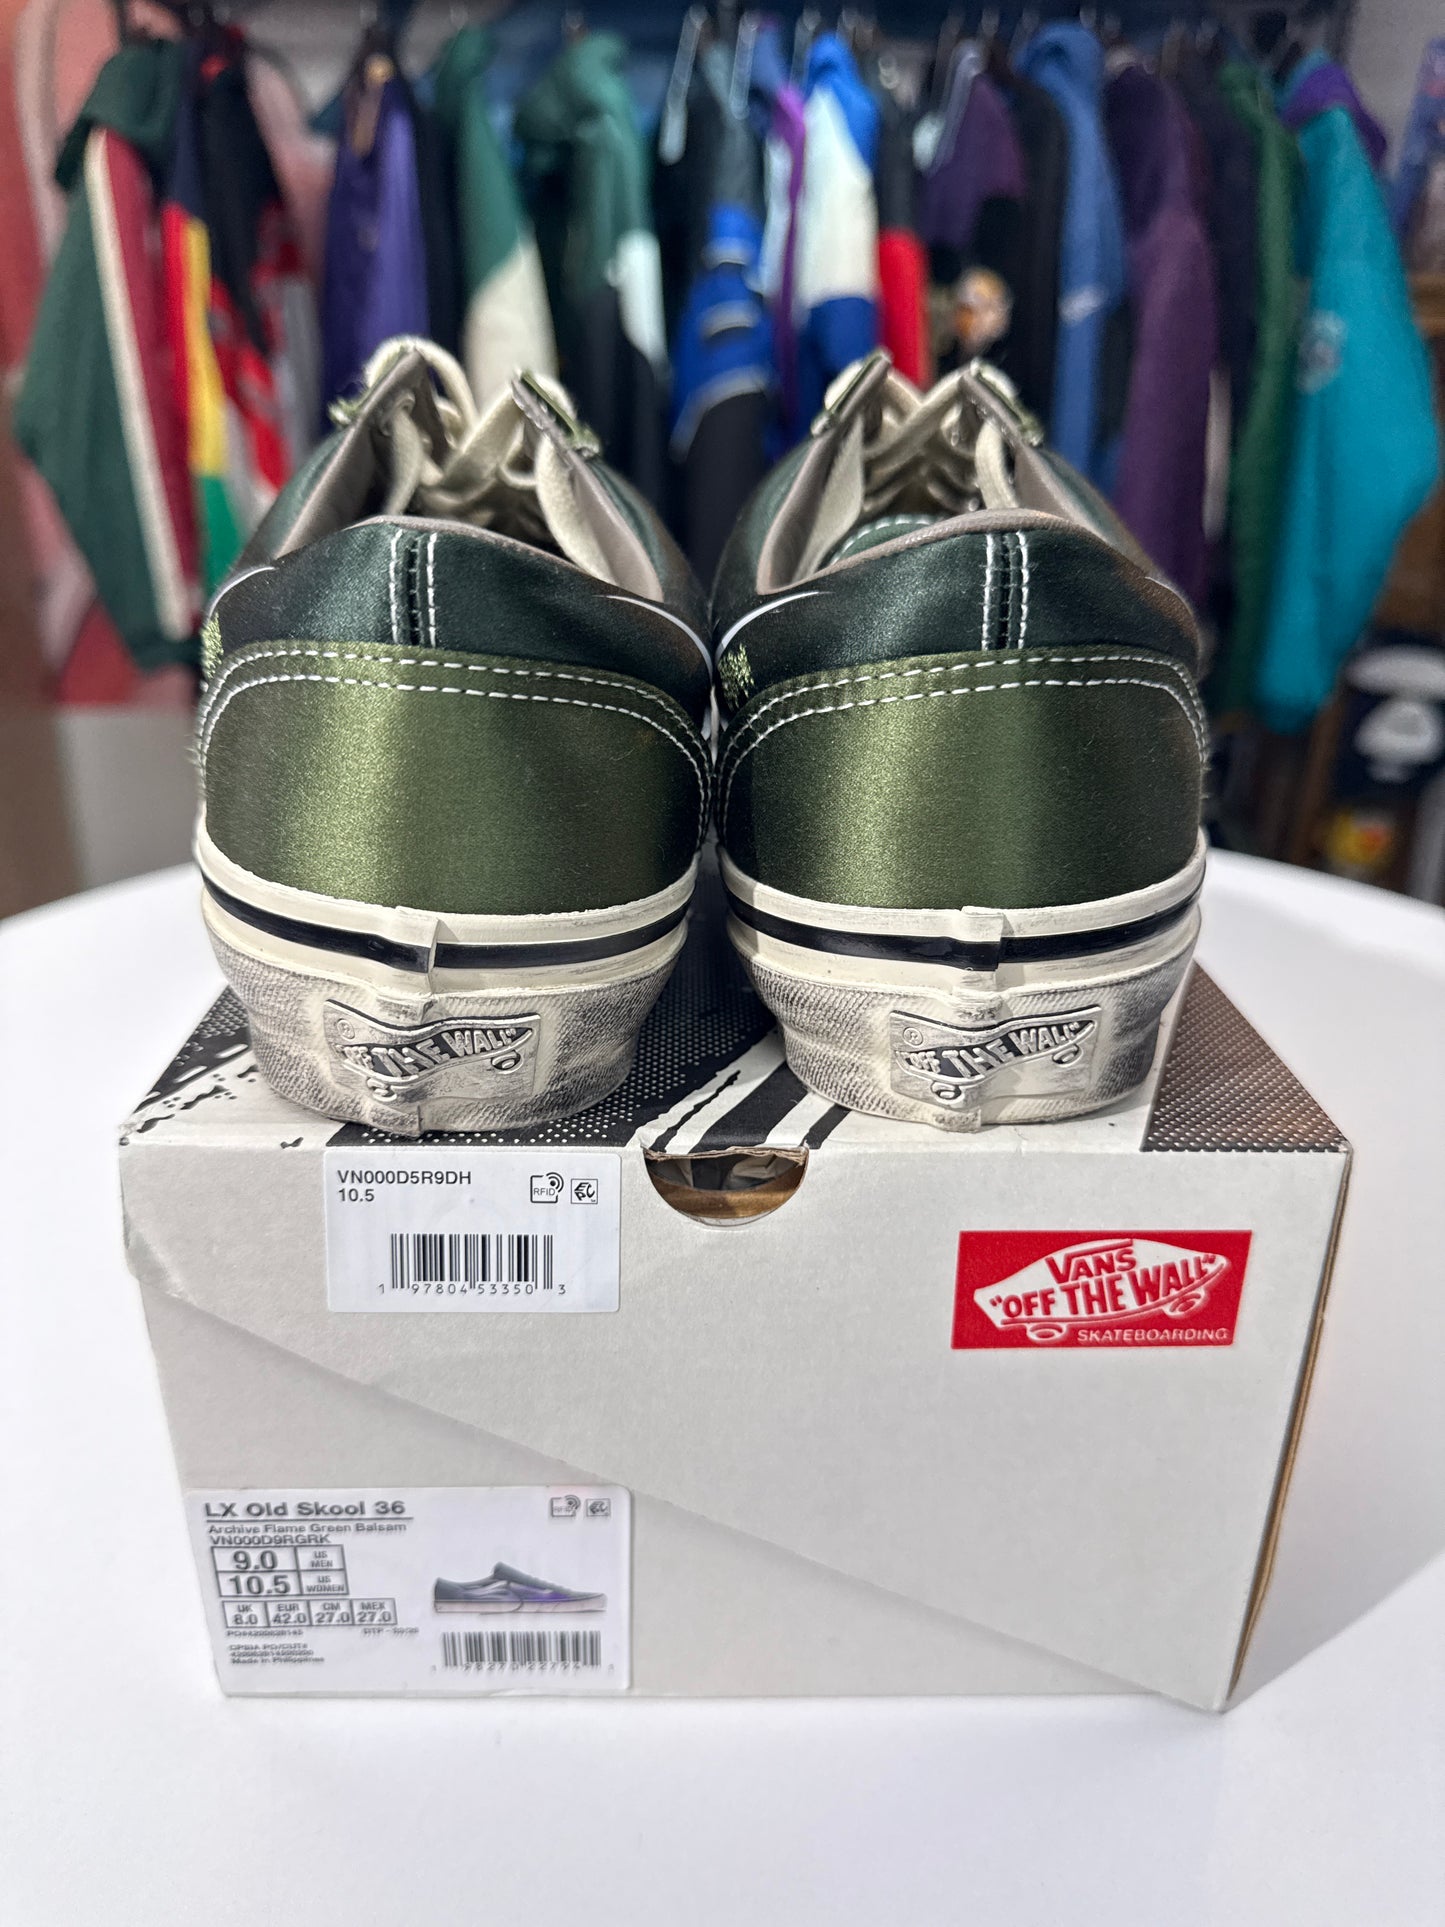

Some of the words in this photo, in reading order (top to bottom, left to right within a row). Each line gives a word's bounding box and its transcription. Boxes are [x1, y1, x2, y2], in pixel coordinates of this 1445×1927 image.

[371, 1039, 451, 1078] THE
[941, 1039, 1015, 1078] THE
[337, 1170, 472, 1184] VN000D5R9DH
[338, 1188, 375, 1202] 10.5
[533, 1187, 556, 1196] RFID
[1045, 1240, 1137, 1284] VANS
[378, 1284, 385, 1294] 1
[412, 1284, 468, 1295] 97804
[477, 1284, 534, 1295] 53350
[558, 1284, 566, 1295] 3
[1060, 1274, 1127, 1316] THE
[1077, 1328, 1228, 1343] SKATEBOARDING
[205, 1502, 238, 1517] LX
[246, 1502, 288, 1516] Old
[297, 1501, 366, 1516] Skool
[375, 1501, 405, 1515] 36
[208, 1525, 260, 1534] Archive
[264, 1524, 305, 1533] Flame
[310, 1523, 351, 1532] Green
[356, 1523, 407, 1532] Balsam
[210, 1534, 331, 1546] VN000D9RGRK
[232, 1550, 278, 1570] 9.0
[314, 1551, 327, 1559] US
[311, 1560, 333, 1568] MEN
[229, 1575, 291, 1594] 10.5
[306, 1585, 345, 1593] WOMEN
[237, 1604, 252, 1612] UK
[278, 1604, 299, 1612] EUR
[323, 1603, 340, 1611] CM
[362, 1602, 385, 1610] MEX
[234, 1614, 258, 1625] 8.0
[273, 1613, 307, 1624] 42.0
[315, 1612, 350, 1623] 27.0
[357, 1612, 391, 1623] 27.0
